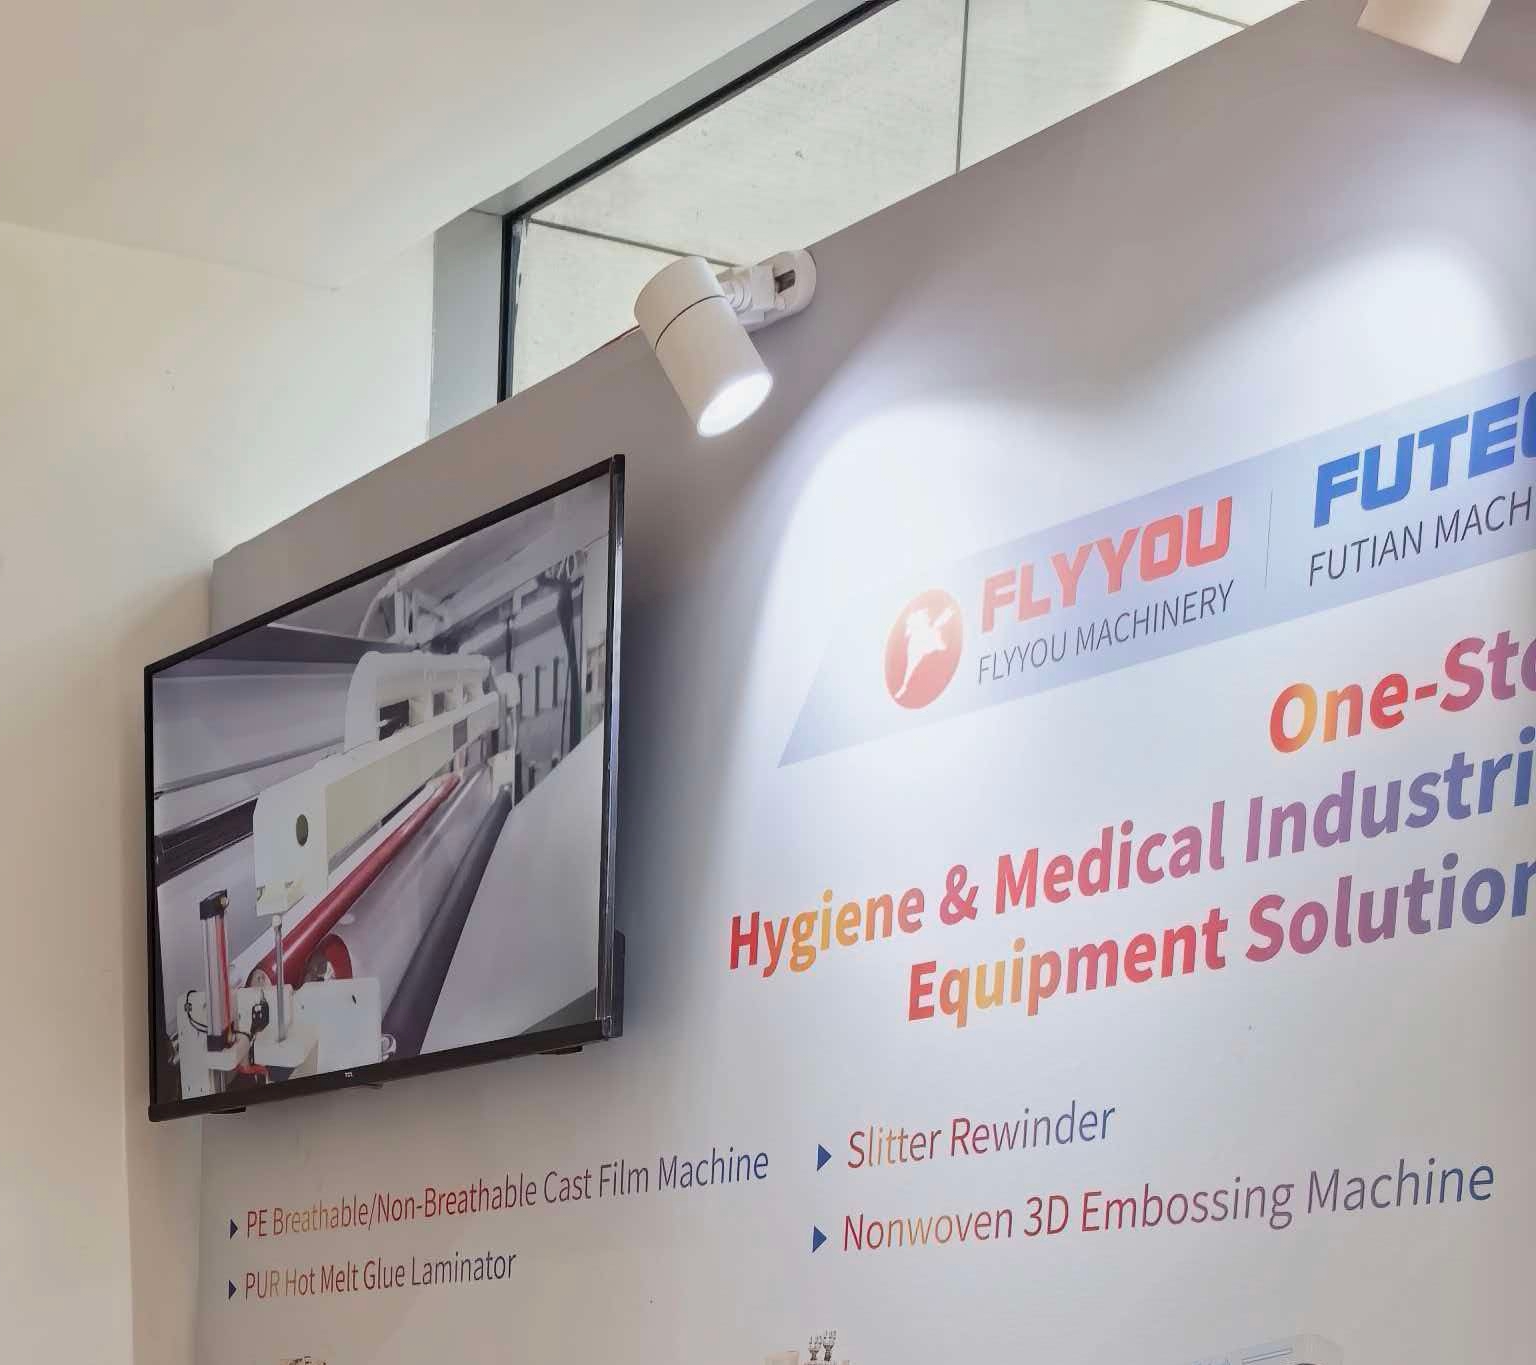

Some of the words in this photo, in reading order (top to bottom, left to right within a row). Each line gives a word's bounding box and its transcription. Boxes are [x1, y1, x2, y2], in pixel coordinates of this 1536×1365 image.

[980, 496, 1233, 633] FLYYOU
[1309, 521, 1423, 587] FUTIAN
[1434, 486, 1532, 550] MACH
[978, 631, 1067, 684] FLYYOU
[1075, 580, 1235, 657] MACHINERY
[729, 887, 925, 978] Hygiene
[939, 864, 979, 925] &
[995, 800, 1225, 914] Medical
[1245, 726, 1536, 864] Industri
[908, 907, 1229, 1028] Equipment
[847, 1125, 942, 1169] Slitter
[950, 1100, 1116, 1157] Rewinder
[246, 1208, 268, 1238] PE
[272, 1171, 537, 1237] Breathable/Non-Breathable
[543, 1167, 593, 1204] Cast
[599, 1159, 649, 1198] Film
[657, 1146, 770, 1191] Machine
[843, 1208, 1013, 1252] Nonwoven
[1023, 1194, 1070, 1237] 3D
[1080, 1176, 1295, 1233] Embossing
[1307, 1157, 1495, 1214] Machine
[245, 1269, 281, 1300] PUR
[284, 1268, 316, 1297] Hot
[320, 1260, 359, 1294] Melt
[363, 1256, 406, 1290] Glue
[411, 1250, 517, 1287] Laminator
